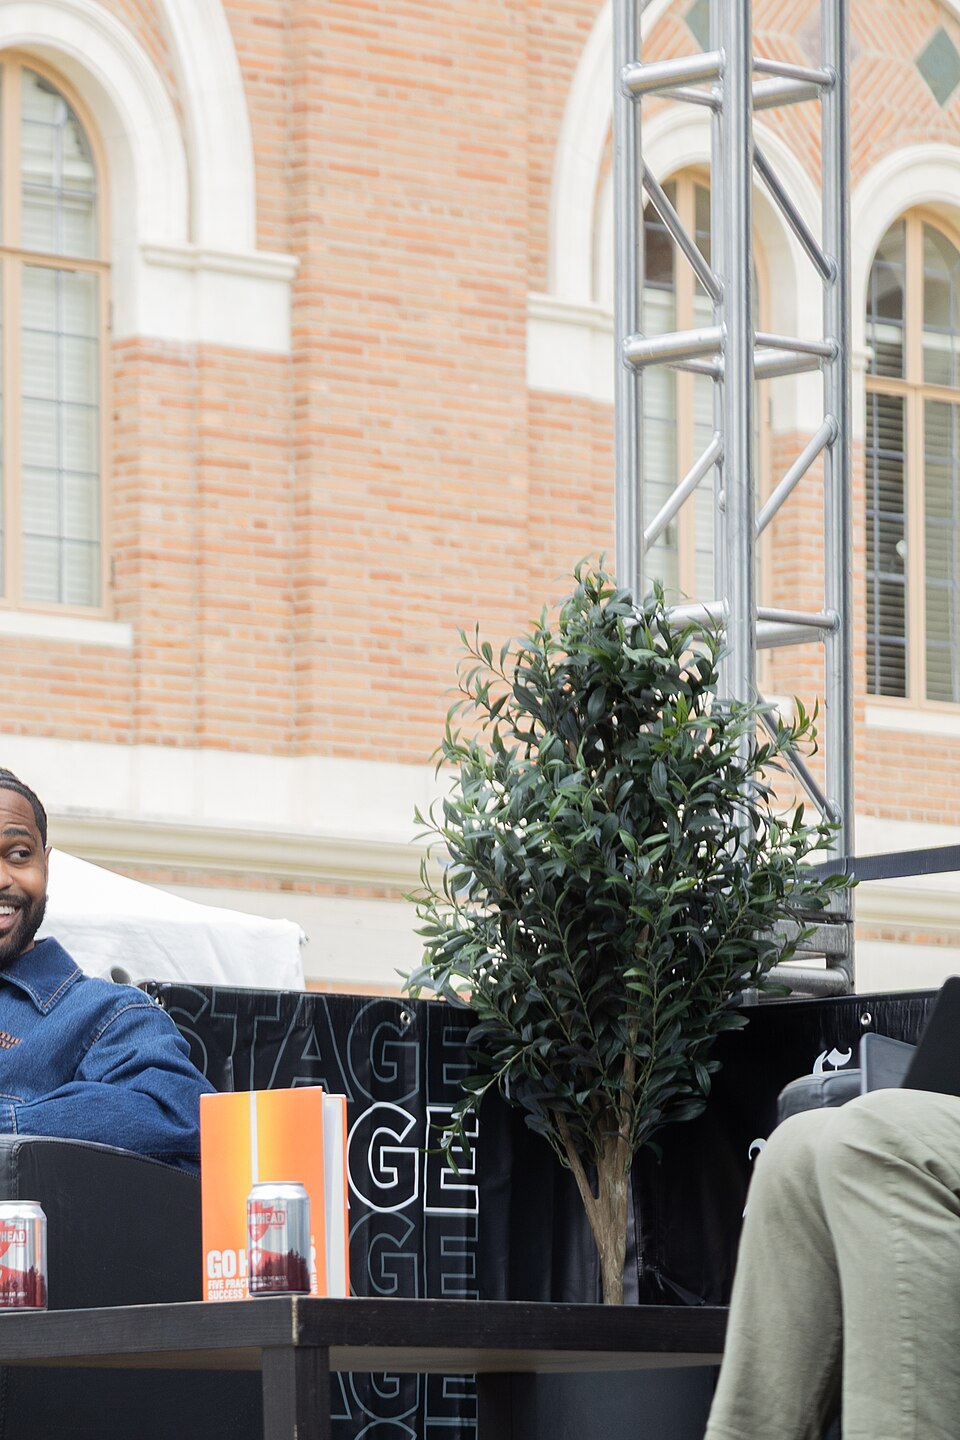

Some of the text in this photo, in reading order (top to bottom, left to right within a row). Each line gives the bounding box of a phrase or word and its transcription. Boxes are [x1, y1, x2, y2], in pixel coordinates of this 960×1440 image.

[207, 1248, 236, 1279] GO
[225, 1277, 249, 1289] PRACT
[208, 1289, 244, 1300] SUCCESS
